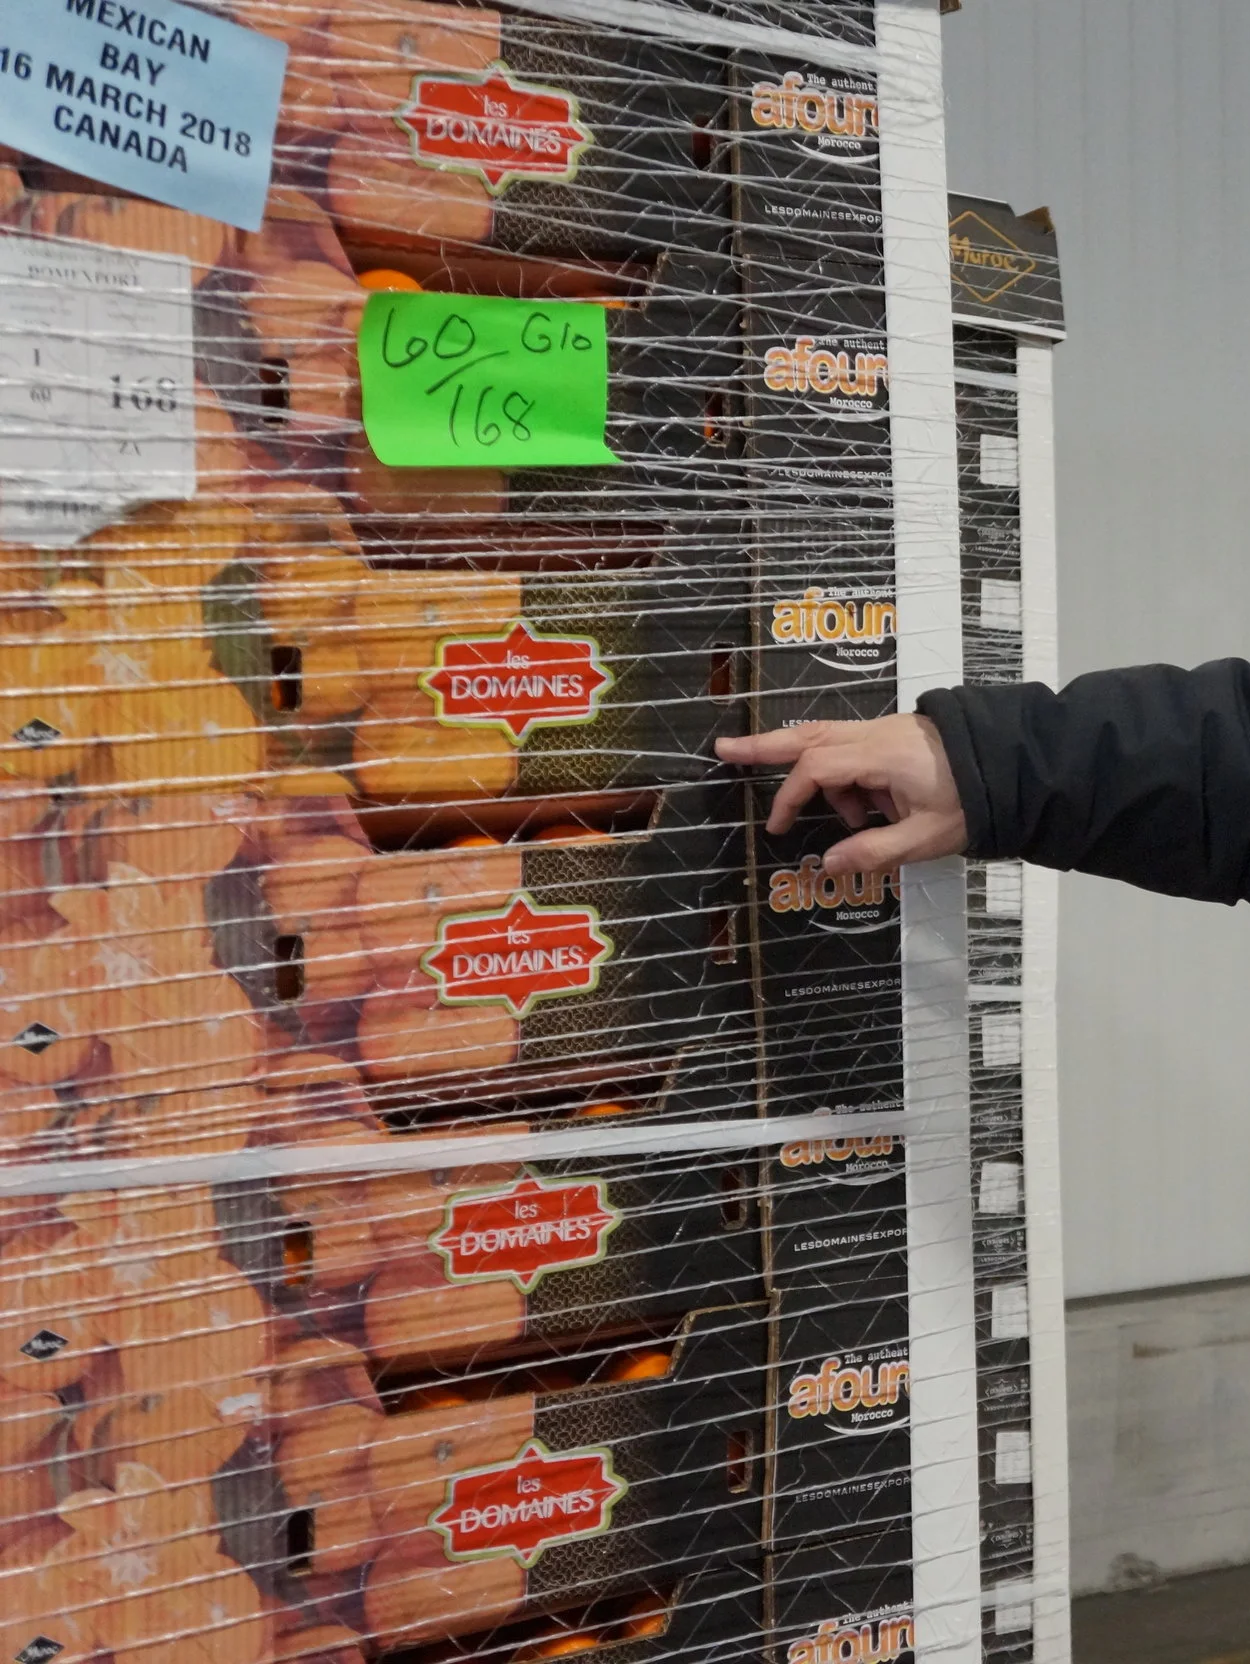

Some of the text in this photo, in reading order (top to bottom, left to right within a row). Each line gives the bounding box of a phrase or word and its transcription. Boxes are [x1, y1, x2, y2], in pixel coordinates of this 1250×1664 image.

[65, 0, 211, 63] MEXICAN
[99, 43, 166, 86] BAY
[807, 73, 877, 92] The authent
[0, 48, 252, 157] 16 MARCH 2018
[483, 95, 508, 117] les
[751, 71, 879, 136] afour
[54, 104, 188, 173] CANADA
[426, 115, 561, 154] DOMAINES
[817, 136, 862, 150] Morocco
[818, 337, 888, 350] The authent
[763, 335, 889, 396] afour
[829, 397, 873, 409] Morocco
[449, 384, 536, 448] 168
[771, 587, 897, 645] afour
[506, 650, 530, 670] les
[836, 647, 880, 658] Morocco
[450, 674, 584, 700] DOMAINES
[836, 909, 880, 921] Morocco
[506, 925, 531, 945] les
[452, 945, 584, 979] DOMAINES
[784, 978, 901, 997] LESDOMAINESEXPOR
[845, 1159, 889, 1173] Morocco
[514, 1200, 538, 1220] les
[460, 1218, 591, 1256] DOMAINES
[844, 1346, 909, 1365] The authent
[787, 1356, 911, 1420] afour
[851, 1409, 894, 1423] Morocco
[516, 1475, 542, 1495] les
[459, 1488, 595, 1534] DOMAINES
[786, 1616, 915, 1664] afour
